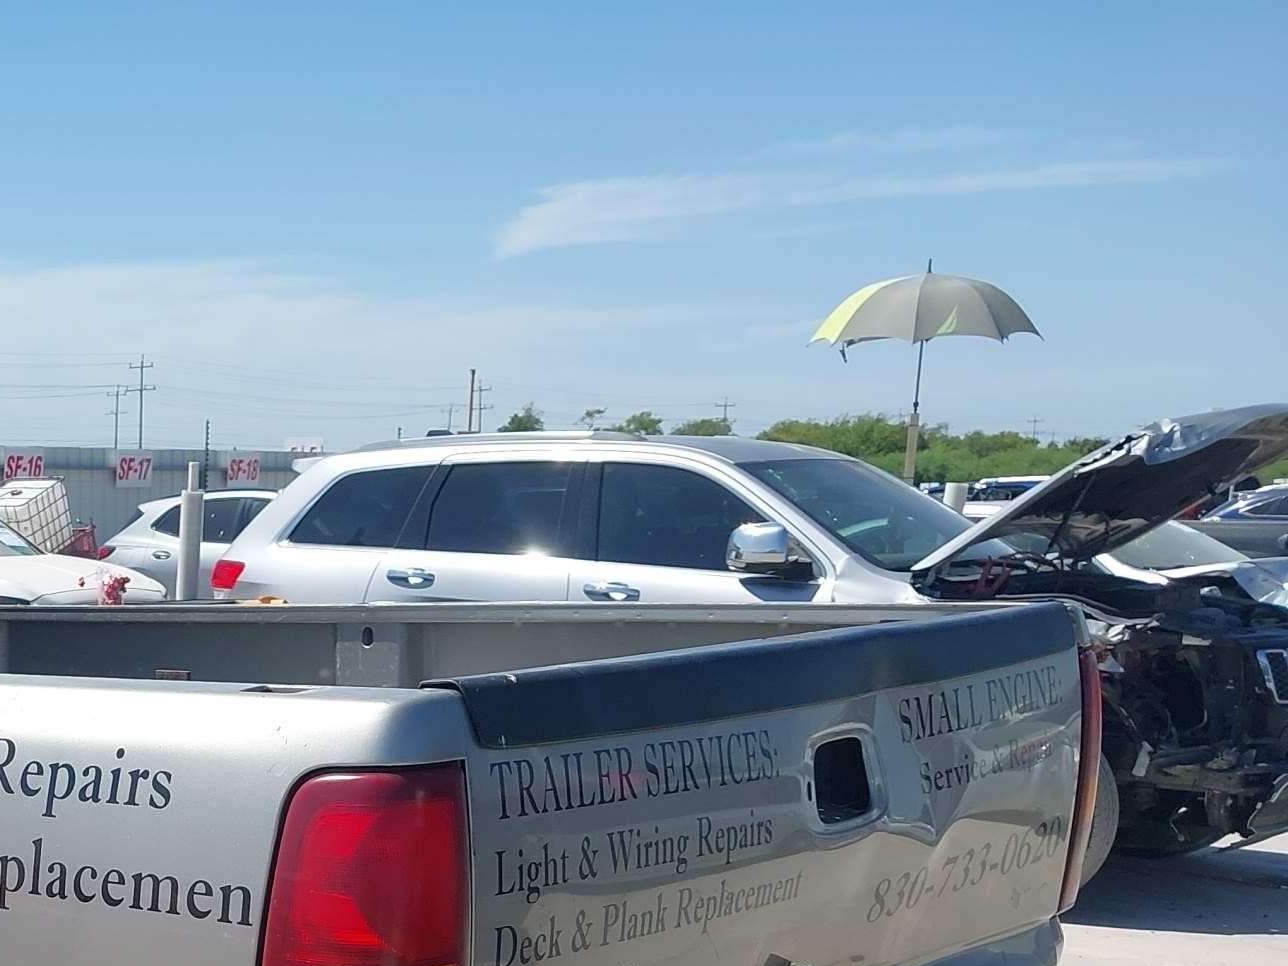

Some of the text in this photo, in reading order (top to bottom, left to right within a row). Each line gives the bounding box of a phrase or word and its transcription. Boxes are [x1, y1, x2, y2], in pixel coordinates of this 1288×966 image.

[6, 455, 43, 479] SF-16
[118, 457, 152, 481] SF-17
[229, 459, 259, 481] SF-18
[898, 665, 1063, 743] SMALL ENGINE:
[489, 730, 780, 820] TRAILER SERVICES:
[920, 754, 986, 794] Service
[992, 744, 1004, 774] &
[495, 809, 773, 904] Light & Wiring Repairs
[867, 816, 1062, 922] 830-733-0620
[571, 910, 593, 953] &
[600, 893, 667, 946] Plank
[674, 869, 804, 934] Replacement
